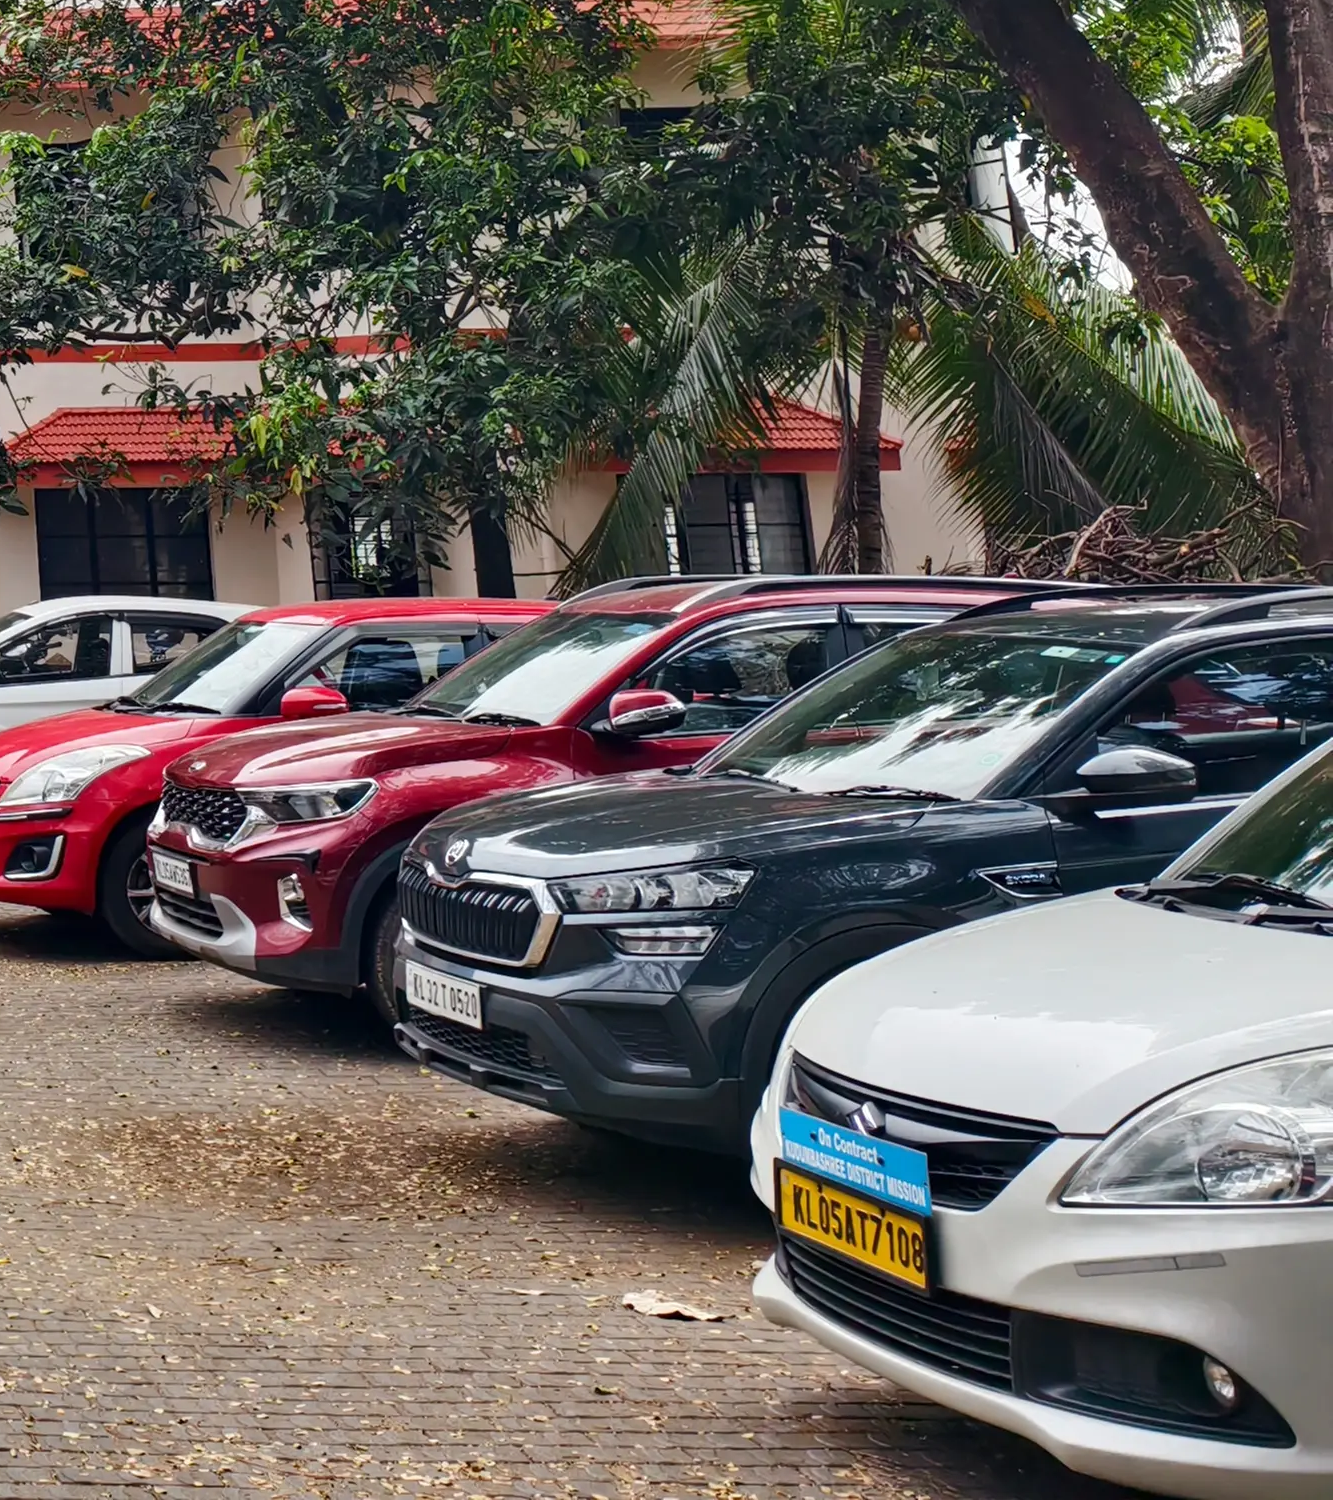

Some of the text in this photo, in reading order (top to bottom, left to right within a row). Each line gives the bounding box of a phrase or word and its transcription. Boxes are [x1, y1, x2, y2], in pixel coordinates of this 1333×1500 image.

[818, 1128, 879, 1165] On Contract
[847, 1162, 885, 1193] DISTRICT
[887, 1175, 926, 1208] MISSION
[793, 1183, 924, 1274] KL05AT7108
